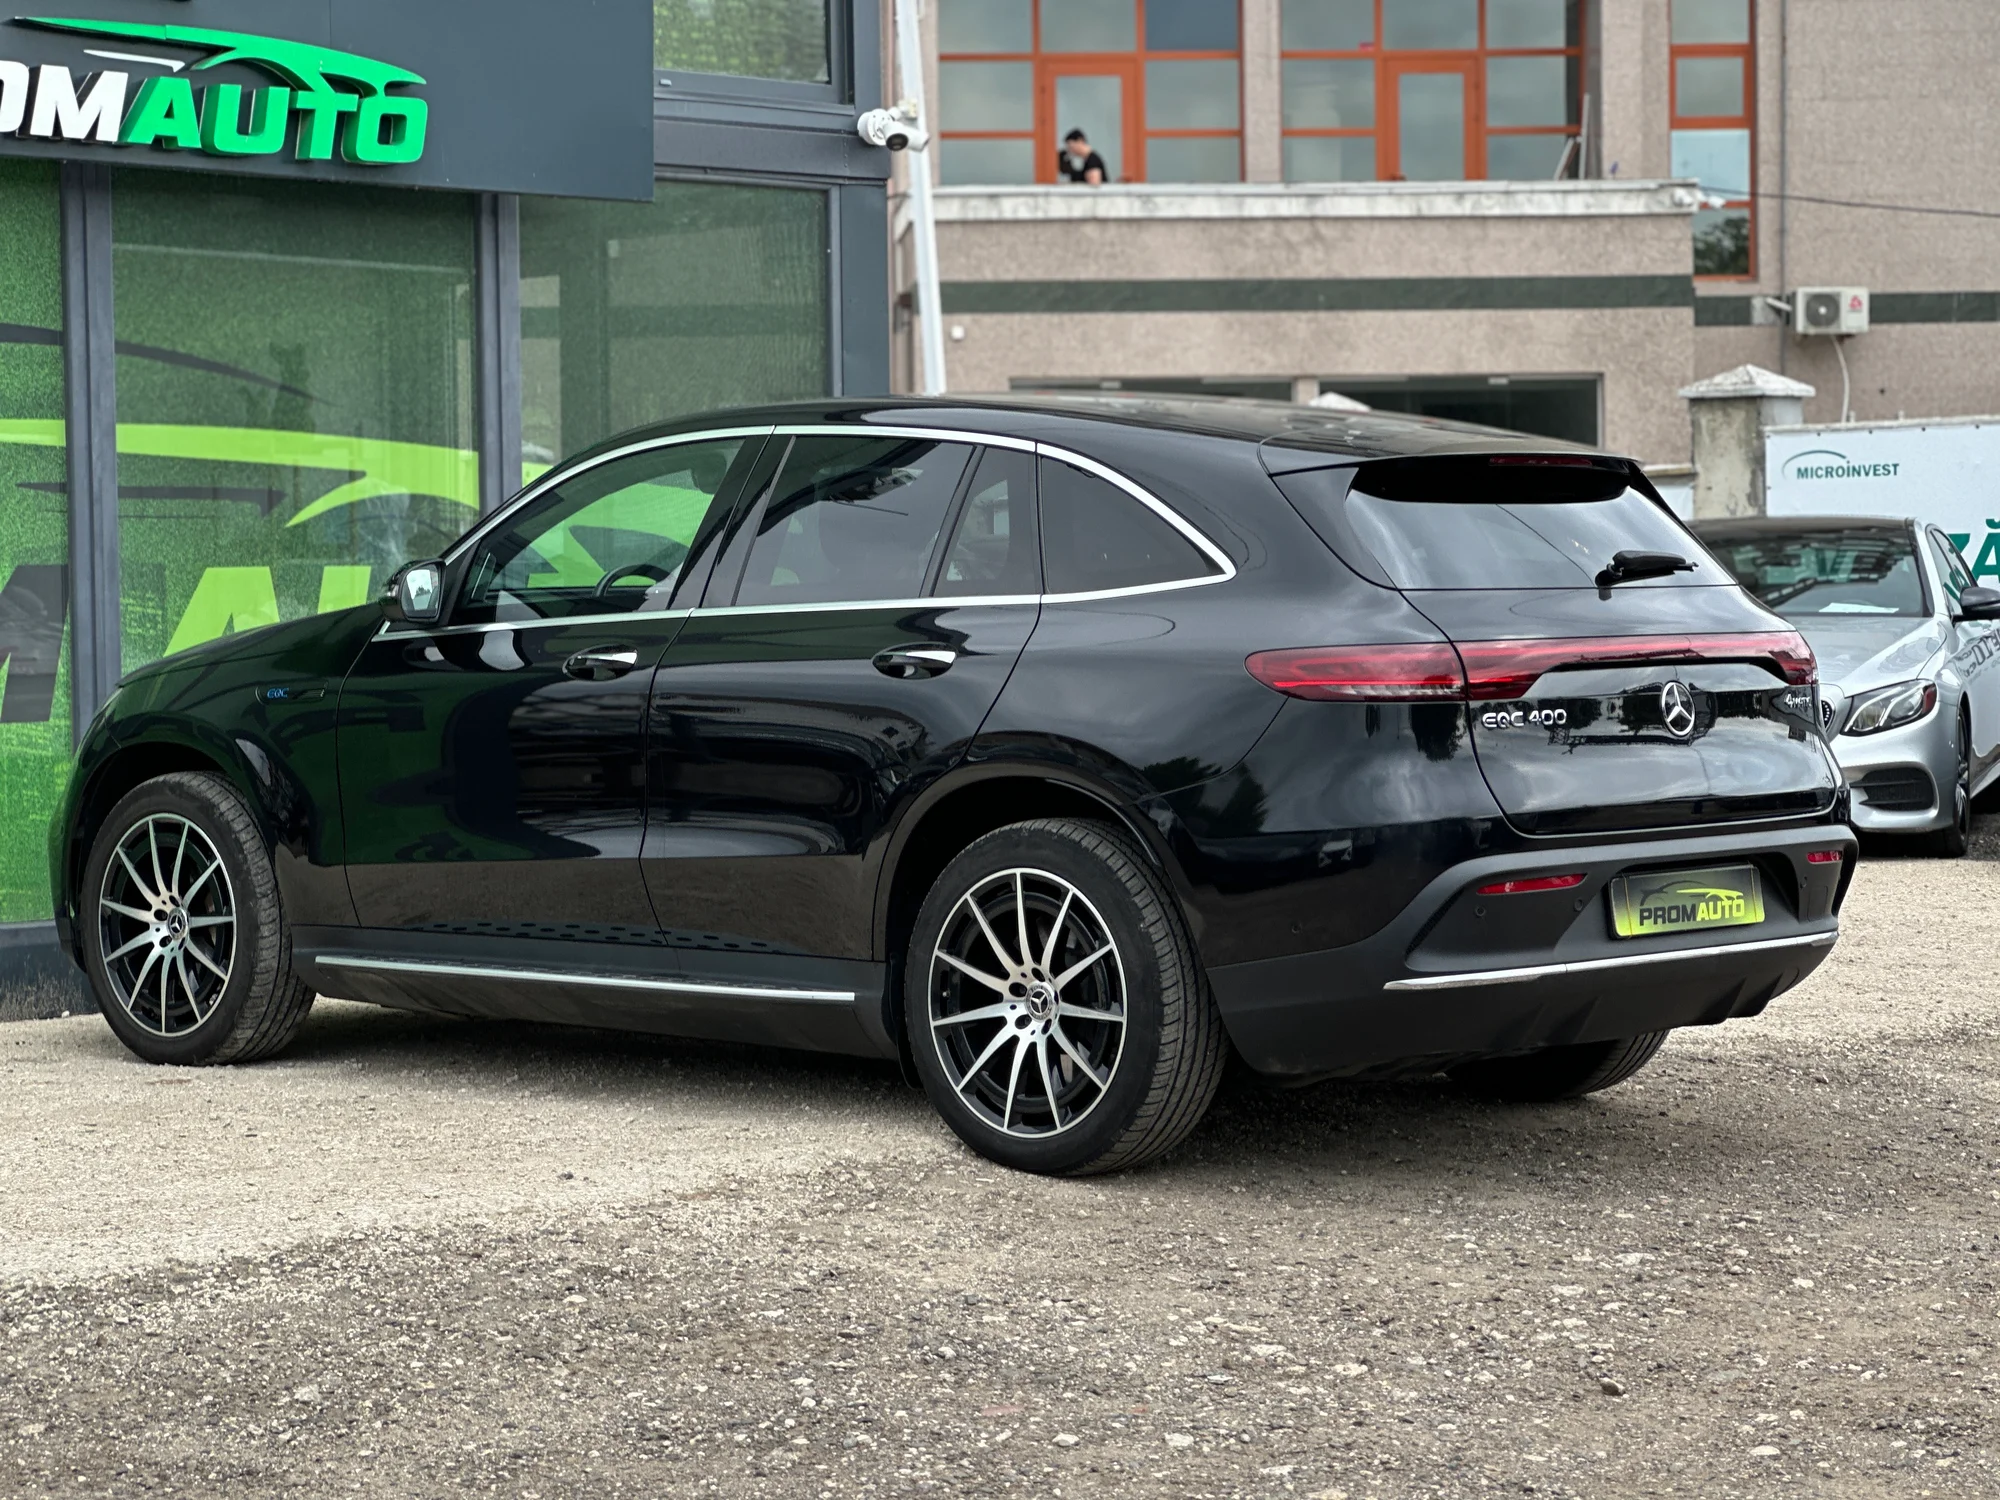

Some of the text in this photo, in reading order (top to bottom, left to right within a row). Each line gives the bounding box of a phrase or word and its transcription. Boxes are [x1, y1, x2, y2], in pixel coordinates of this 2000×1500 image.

[1482, 708, 1567, 728] EQC 400
[1639, 898, 1745, 926] PROMAUTO
